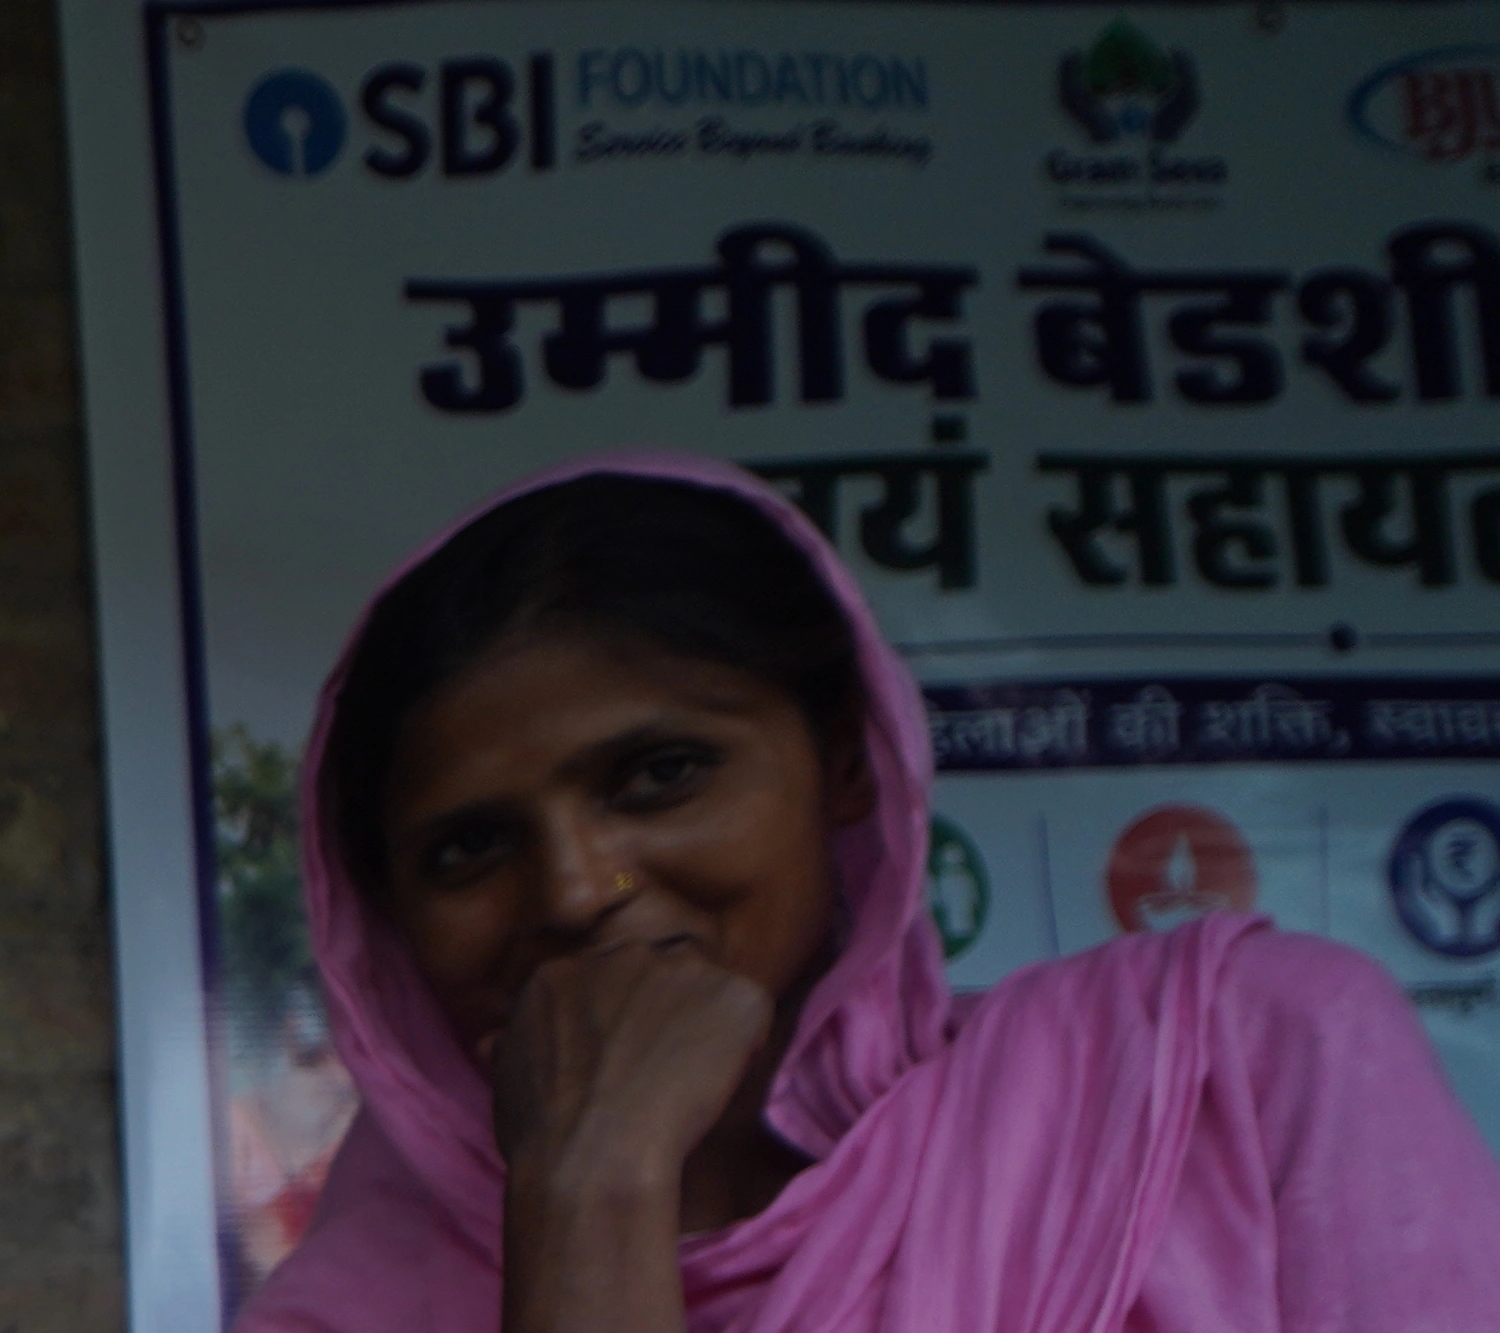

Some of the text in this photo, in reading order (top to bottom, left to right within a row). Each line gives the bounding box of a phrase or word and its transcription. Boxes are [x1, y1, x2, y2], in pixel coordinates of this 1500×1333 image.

[360, 54, 554, 178] SBI
[578, 48, 930, 108] FOUNDATION
[404, 222, 980, 414] उम्मीद
[1108, 684, 1180, 756] की
